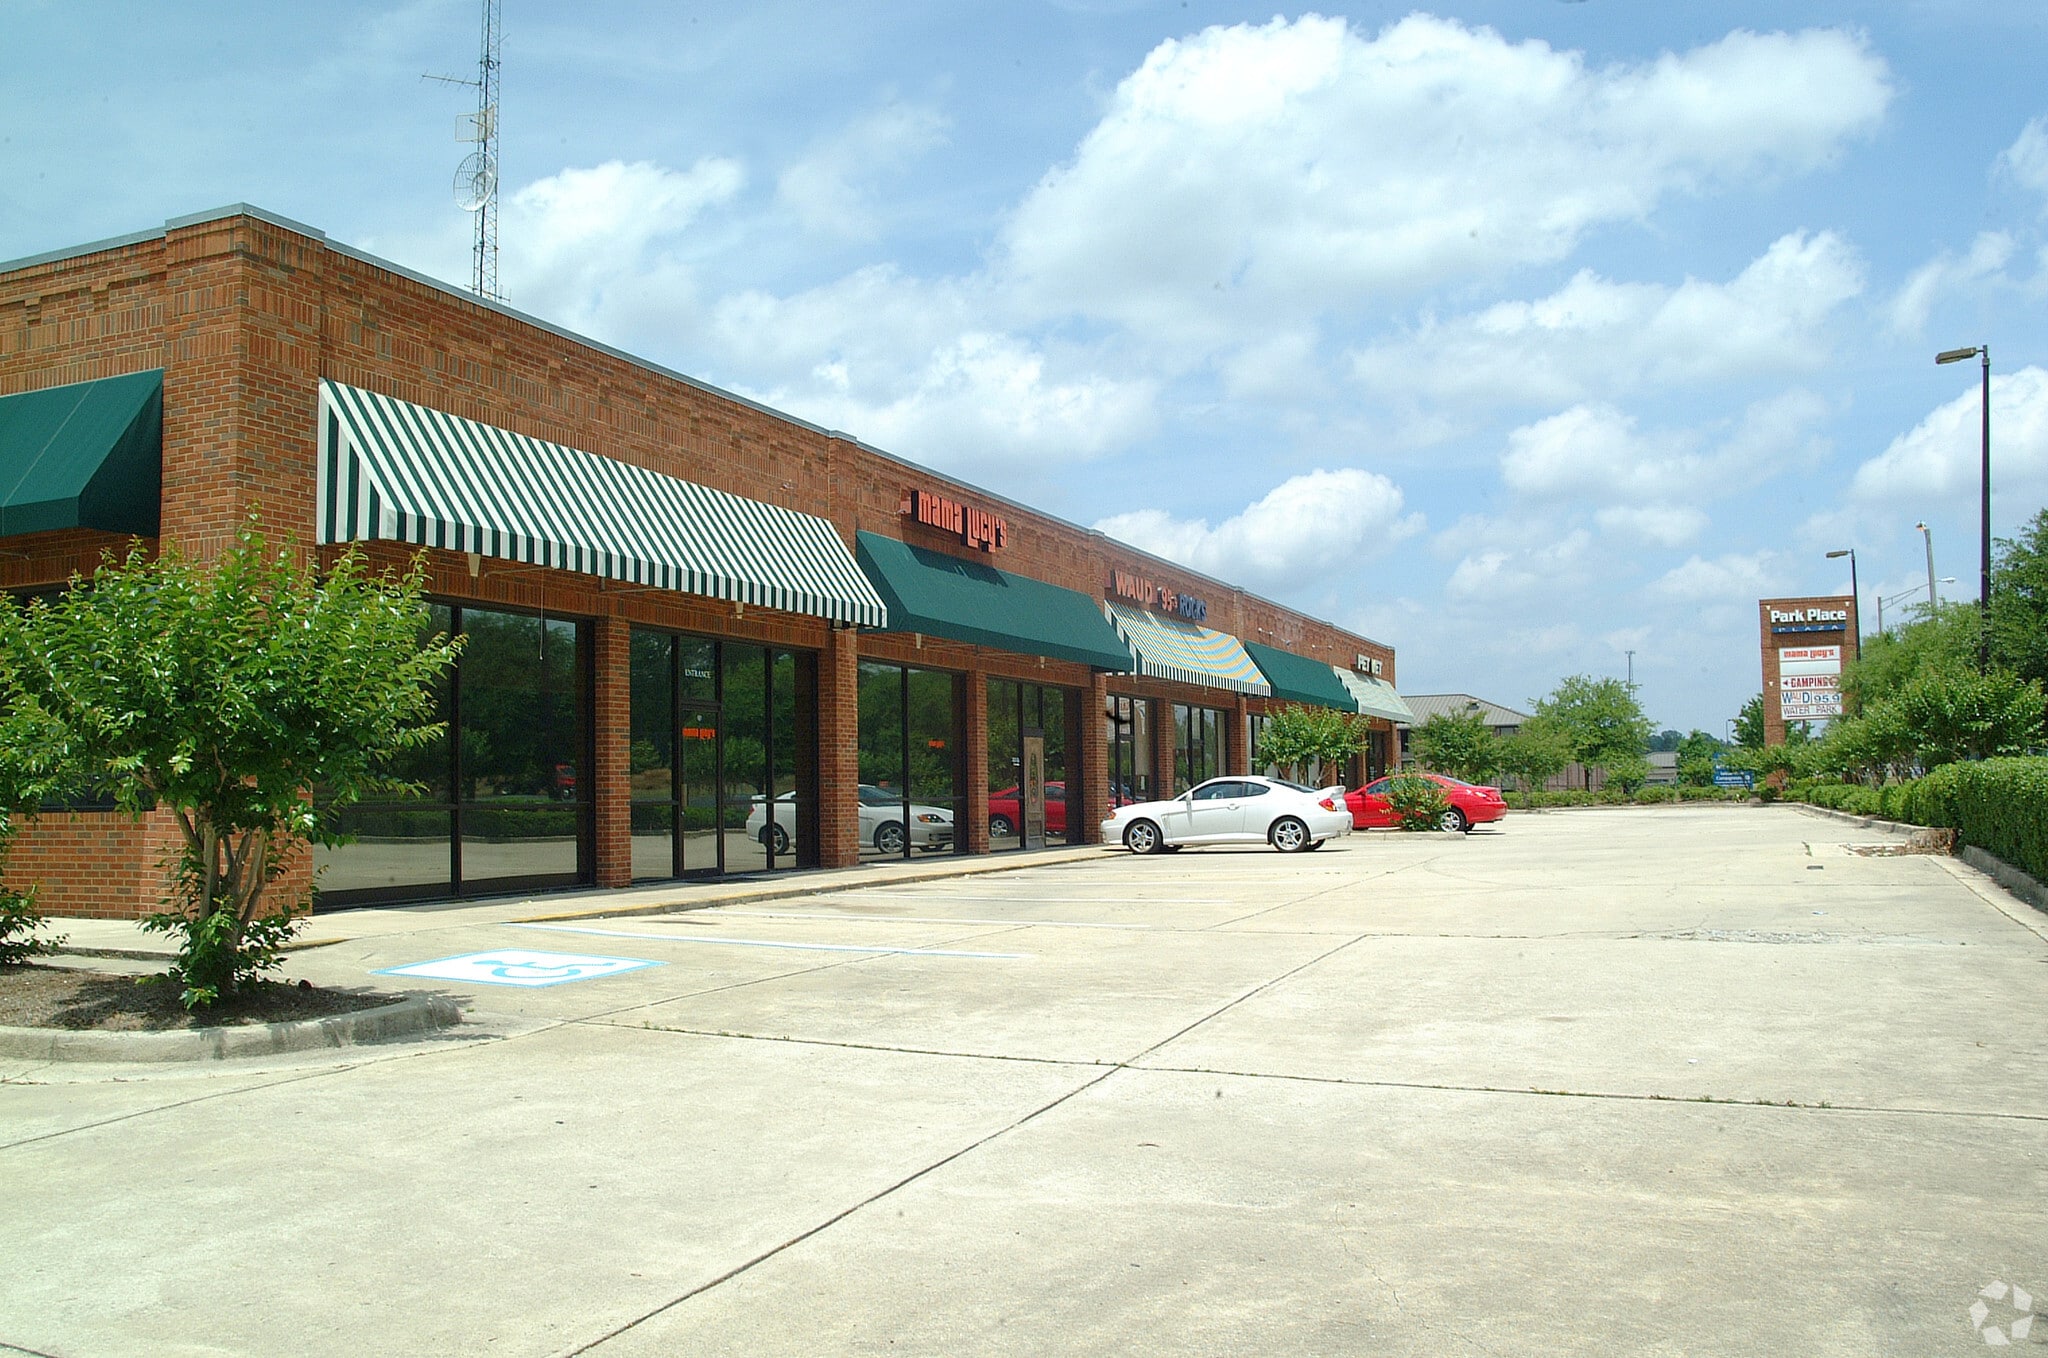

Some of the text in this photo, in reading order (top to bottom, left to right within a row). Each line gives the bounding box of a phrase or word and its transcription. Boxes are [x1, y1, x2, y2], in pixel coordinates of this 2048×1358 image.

[1114, 569, 1153, 604] WAUD
[1179, 592, 1207, 622] ROCKS
[1770, 608, 1847, 623] Park Place
[1791, 676, 1829, 688] CAMPING
[1783, 705, 1838, 715] WATER PARK
